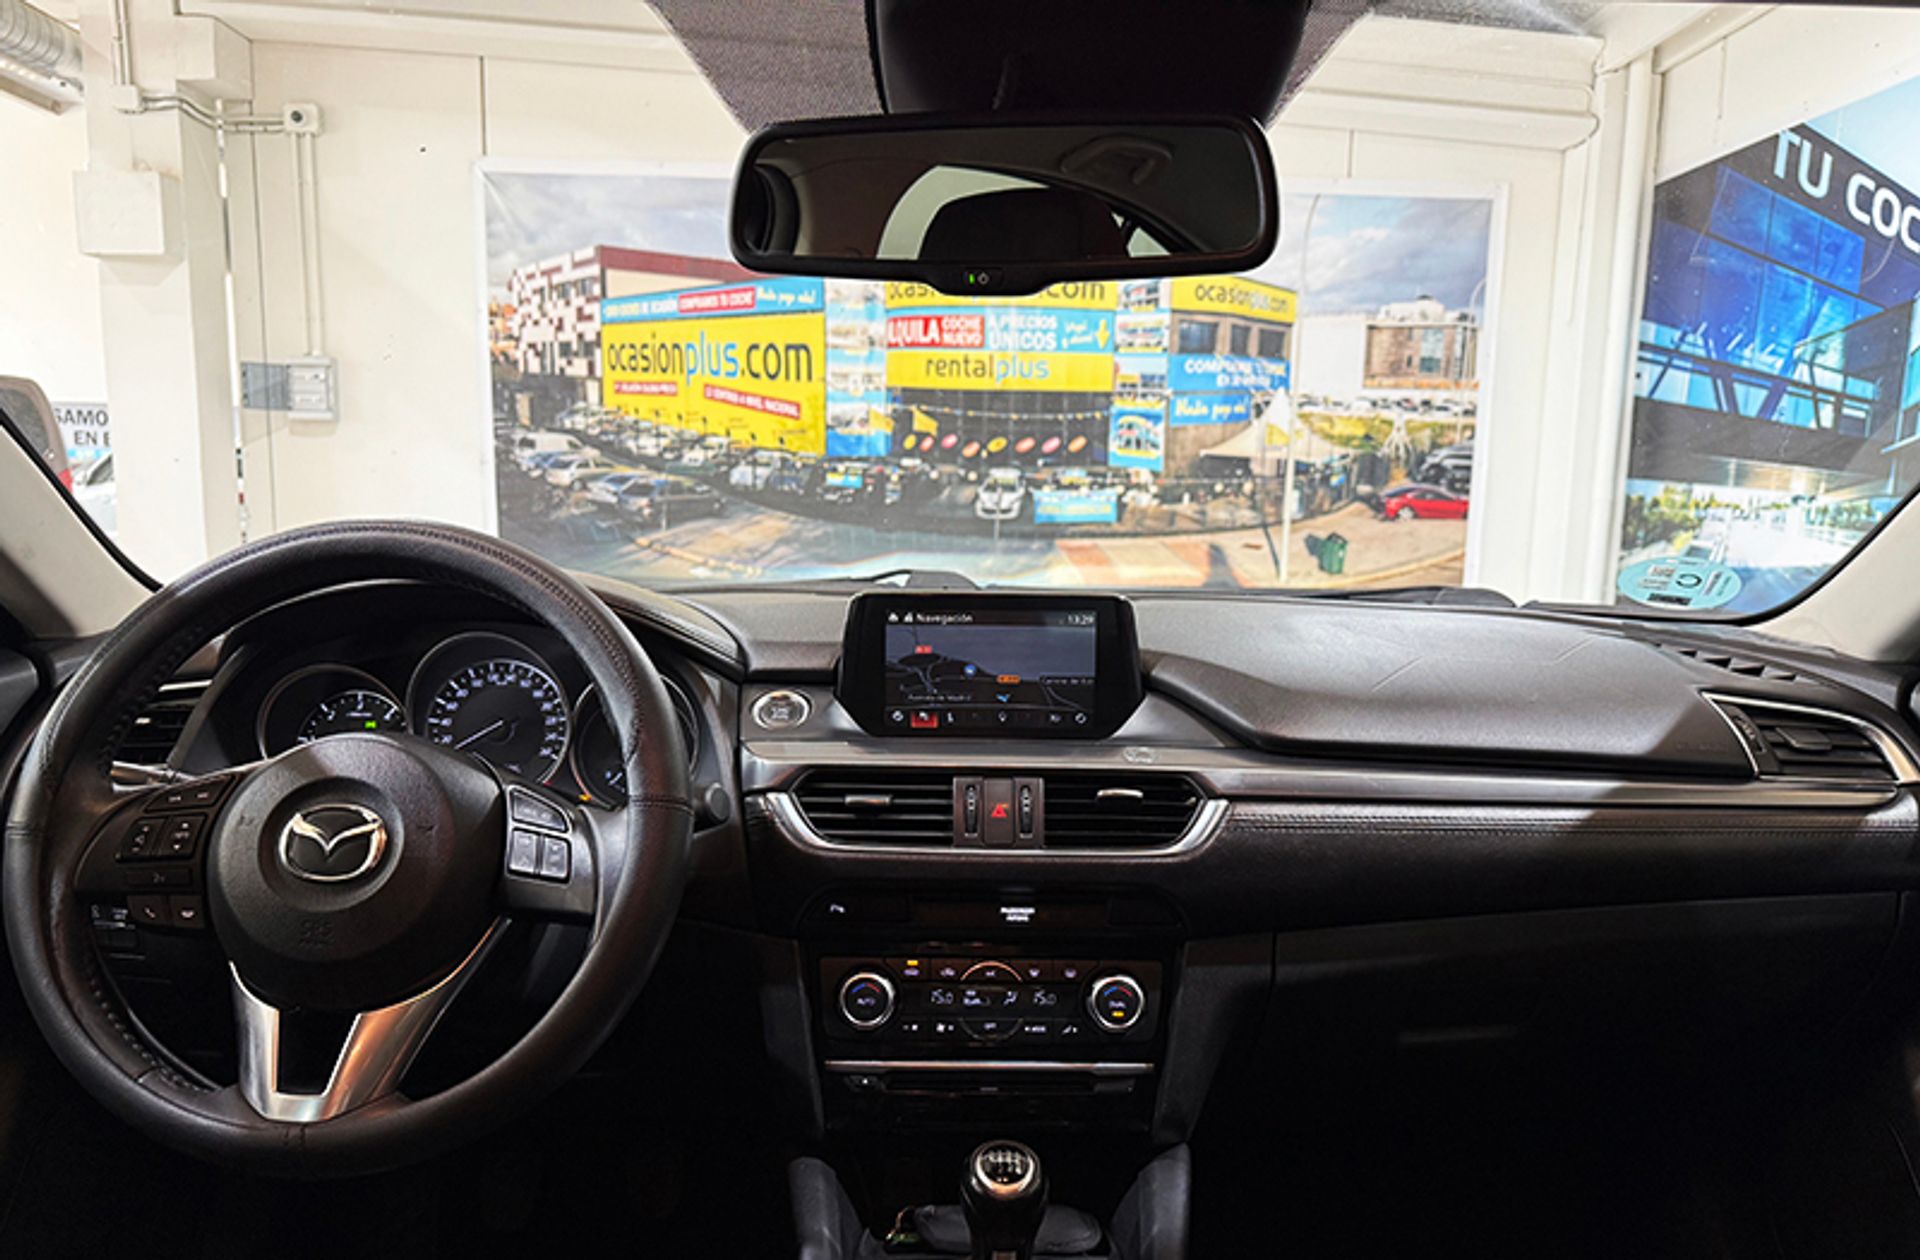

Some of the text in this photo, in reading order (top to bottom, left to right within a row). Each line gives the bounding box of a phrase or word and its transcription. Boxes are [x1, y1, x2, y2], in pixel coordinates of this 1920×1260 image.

[1774, 128, 1920, 253] TU COC
[608, 330, 813, 387] ocasionplus.com
[926, 354, 1050, 383] rentalplus
[74, 430, 98, 446] EN
[917, 612, 973, 625] Navegación
